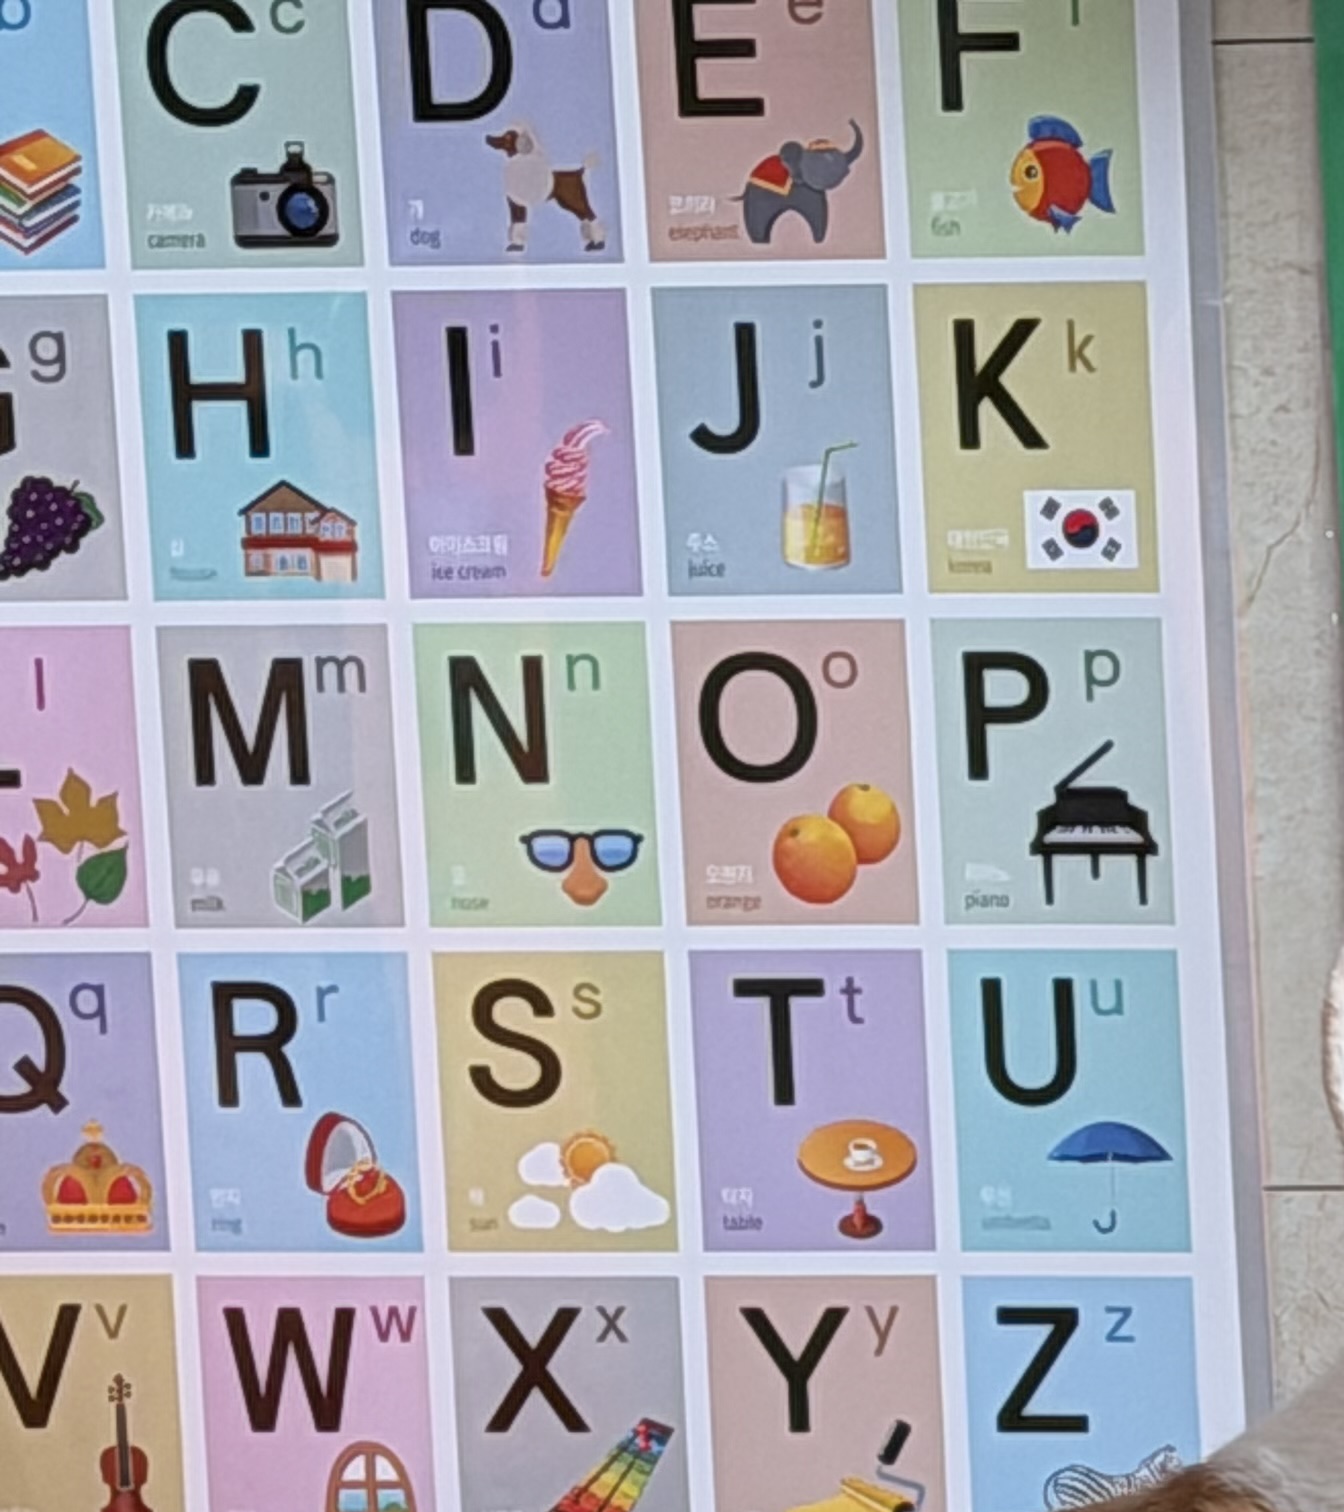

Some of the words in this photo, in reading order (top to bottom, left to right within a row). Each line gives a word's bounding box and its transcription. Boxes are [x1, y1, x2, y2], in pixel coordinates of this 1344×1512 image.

[146, 0, 261, 127] C
[269, 0, 306, 35] c
[406, 0, 513, 123] D
[673, 0, 765, 117] E
[937, 0, 1021, 111] F
[29, 330, 67, 383] g
[167, 329, 271, 460] H
[287, 327, 324, 380] h
[445, 326, 475, 456] I
[488, 325, 503, 378] i
[689, 322, 761, 455] J
[808, 319, 825, 389] j
[952, 318, 1050, 451] K
[1066, 319, 1097, 374] k
[187, 657, 311, 787] M
[315, 653, 367, 694] m
[448, 655, 550, 785] N
[565, 652, 601, 692] n
[698, 651, 818, 784] O
[822, 651, 858, 689] o
[962, 651, 1050, 781] P
[1083, 649, 1121, 702] p
[964, 888, 1010, 911] piano
[68, 981, 108, 1036] q
[210, 980, 303, 1109] R
[315, 981, 339, 1023] r
[468, 978, 562, 1109] S
[571, 980, 603, 1021] s
[732, 978, 825, 1107] T
[839, 975, 865, 1025] t
[980, 977, 1077, 1108] U
[1089, 978, 1124, 1016] u
[0, 1303, 82, 1429] V
[94, 1303, 128, 1341] v
[222, 1307, 356, 1433] W
[369, 1305, 417, 1344] w
[481, 1307, 592, 1433] X
[595, 1305, 630, 1344] x
[739, 1307, 850, 1433] Y
[865, 1305, 900, 1358] y
[996, 1307, 1089, 1433] Z
[1104, 1306, 1136, 1343] z
